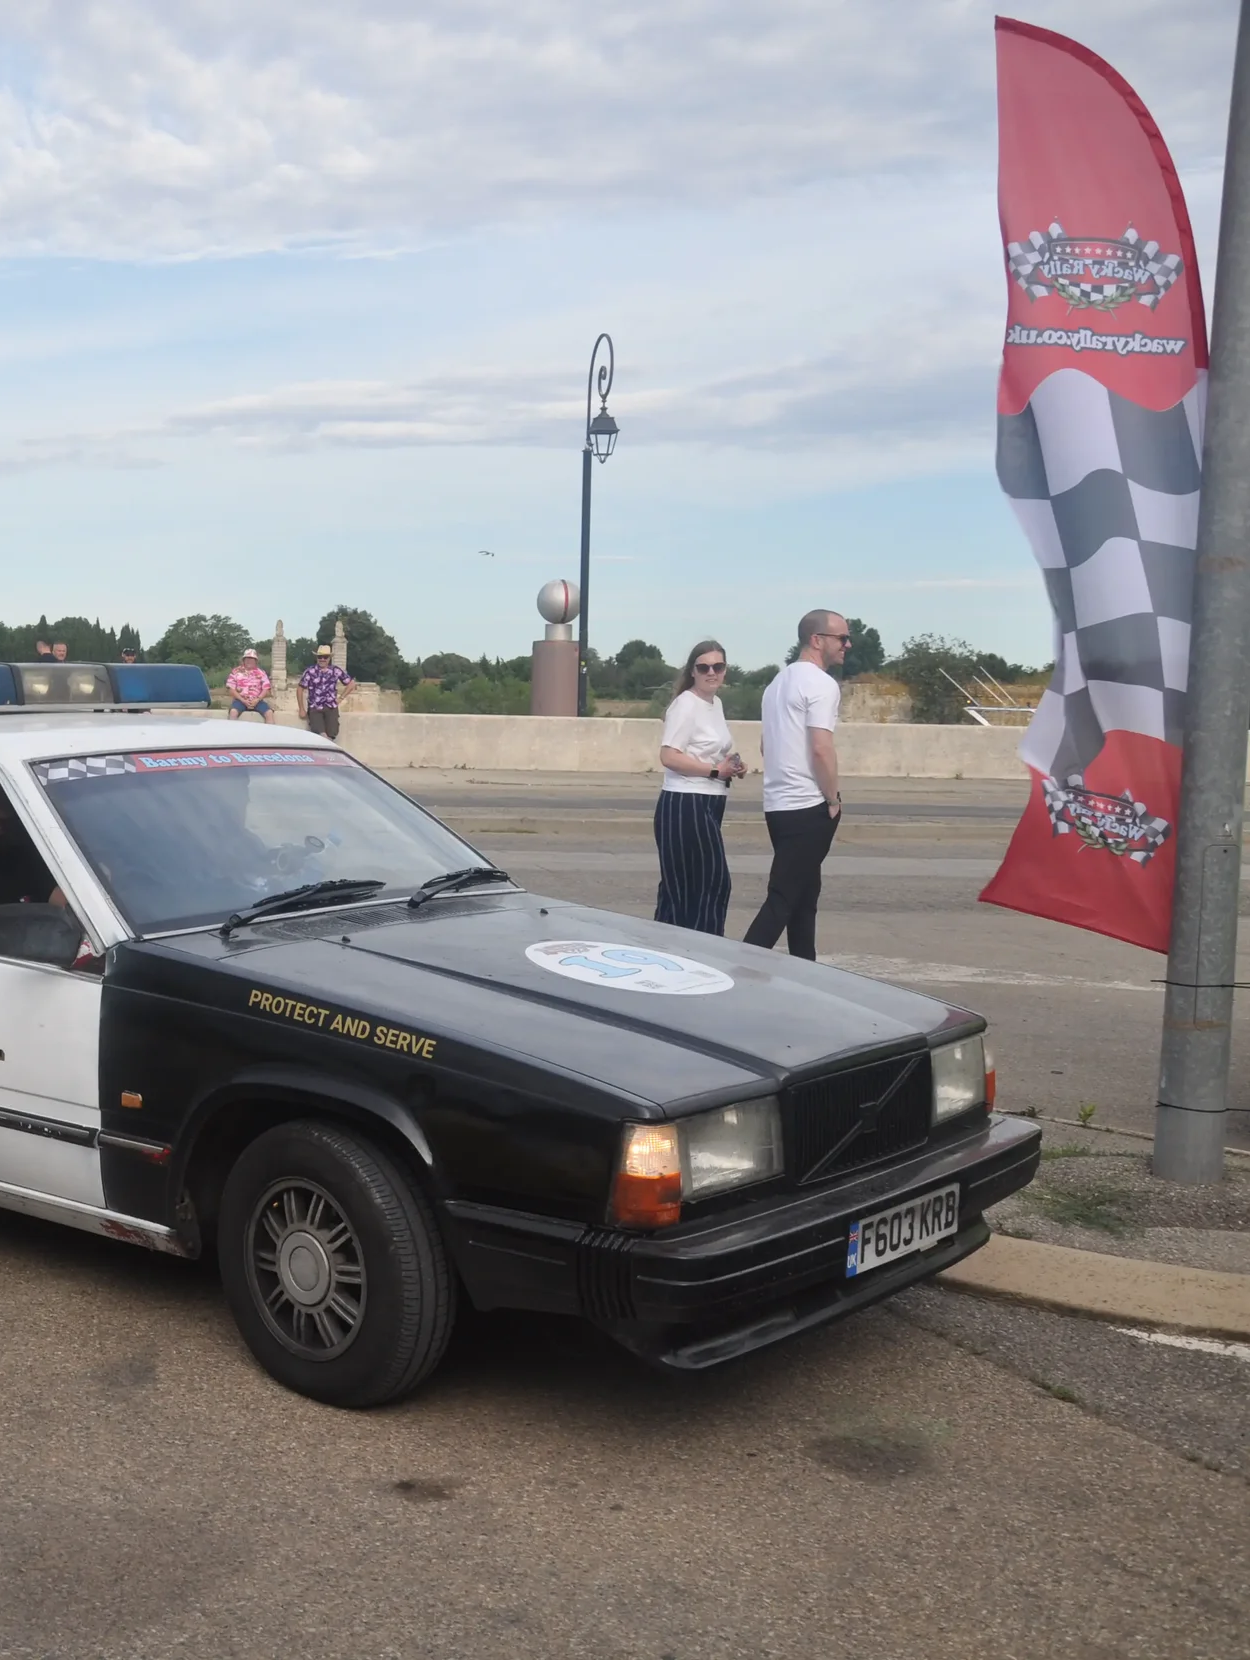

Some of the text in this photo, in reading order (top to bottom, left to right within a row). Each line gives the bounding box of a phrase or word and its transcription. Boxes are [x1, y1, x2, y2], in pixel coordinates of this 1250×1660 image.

[138, 752, 315, 769] Barmy to Barcelona
[558, 949, 685, 979] 19
[248, 989, 437, 1059] PROTECT AND SERVE
[860, 1190, 956, 1264] F603 KRB
[847, 1253, 857, 1268] UK
